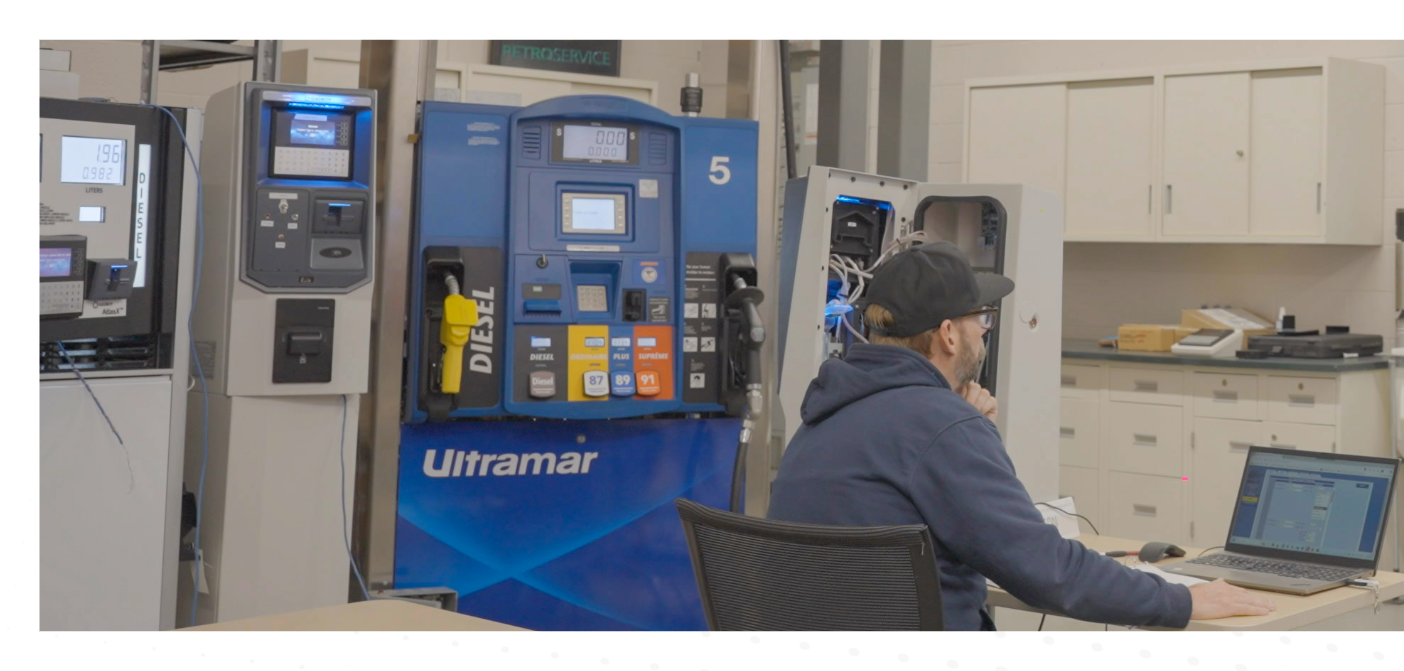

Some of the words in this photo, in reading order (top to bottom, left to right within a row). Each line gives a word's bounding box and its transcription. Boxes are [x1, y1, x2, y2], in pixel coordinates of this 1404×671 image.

[502, 44, 611, 66] PETROSERVICE
[708, 155, 731, 185] 5
[136, 172, 146, 259] DIESEL
[469, 286, 495, 374] DIESEL
[530, 353, 554, 361] DIESEL
[613, 353, 630, 361] PLUS
[532, 376, 554, 386] Diesel
[589, 375, 604, 385] 87
[615, 374, 631, 385] 89
[640, 374, 655, 385] 91
[423, 448, 599, 478] Ultramar
